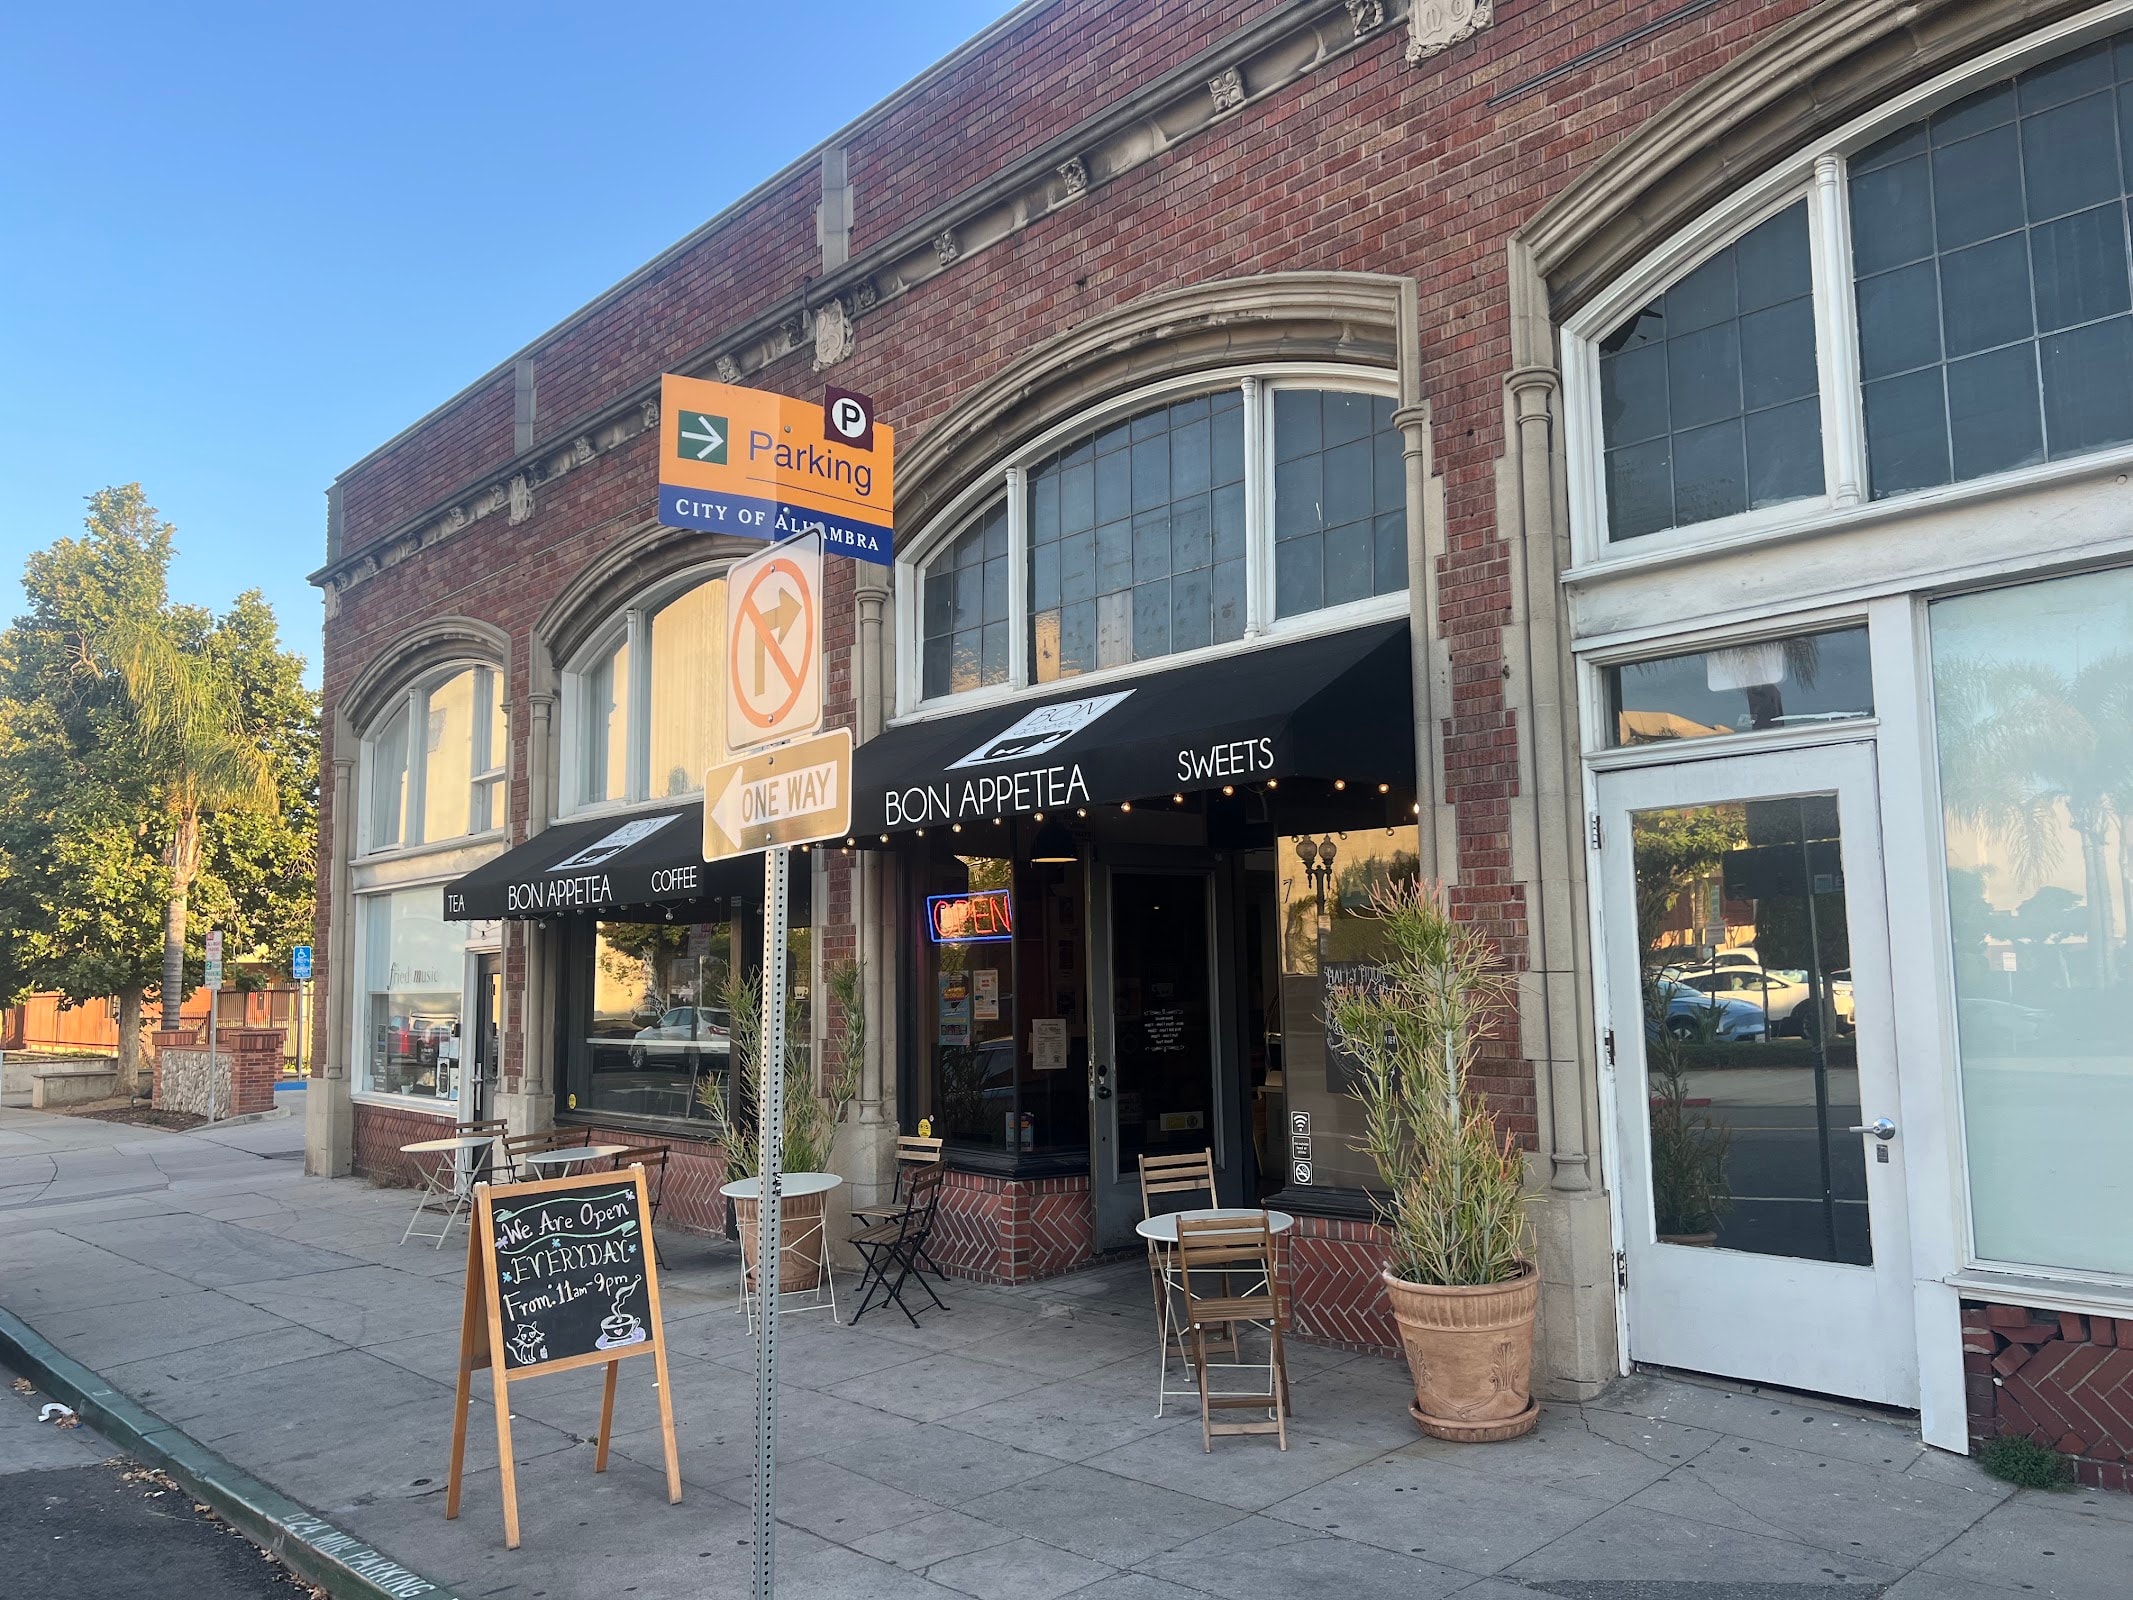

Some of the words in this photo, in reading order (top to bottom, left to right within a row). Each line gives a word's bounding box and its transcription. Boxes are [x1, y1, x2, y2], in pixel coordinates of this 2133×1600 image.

[841, 402, 860, 431] P
[750, 430, 872, 496] Parking
[675, 499, 728, 521] CITY
[738, 508, 766, 526] OF
[775, 513, 879, 551] ALMBRA
[1027, 698, 1111, 726] BON
[1177, 737, 1275, 782] SWEETS
[742, 780, 779, 823] ONE
[787, 767, 832, 811] WAY
[885, 782, 951, 826] BON
[958, 763, 1090, 818] APPETEA
[508, 883, 545, 911] BON
[546, 874, 612, 907] APPETEA
[651, 865, 697, 892] COFFEE
[448, 894, 465, 913] TEA
[933, 895, 1011, 937] OPEN
[387, 961, 410, 990] fried
[413, 967, 439, 984] music
[502, 1217, 533, 1245] We
[538, 1210, 574, 1236] Are
[580, 1202, 629, 1230] Open
[511, 1239, 631, 1285] EVERYDAY
[343, 1549, 437, 1598] PARKING
